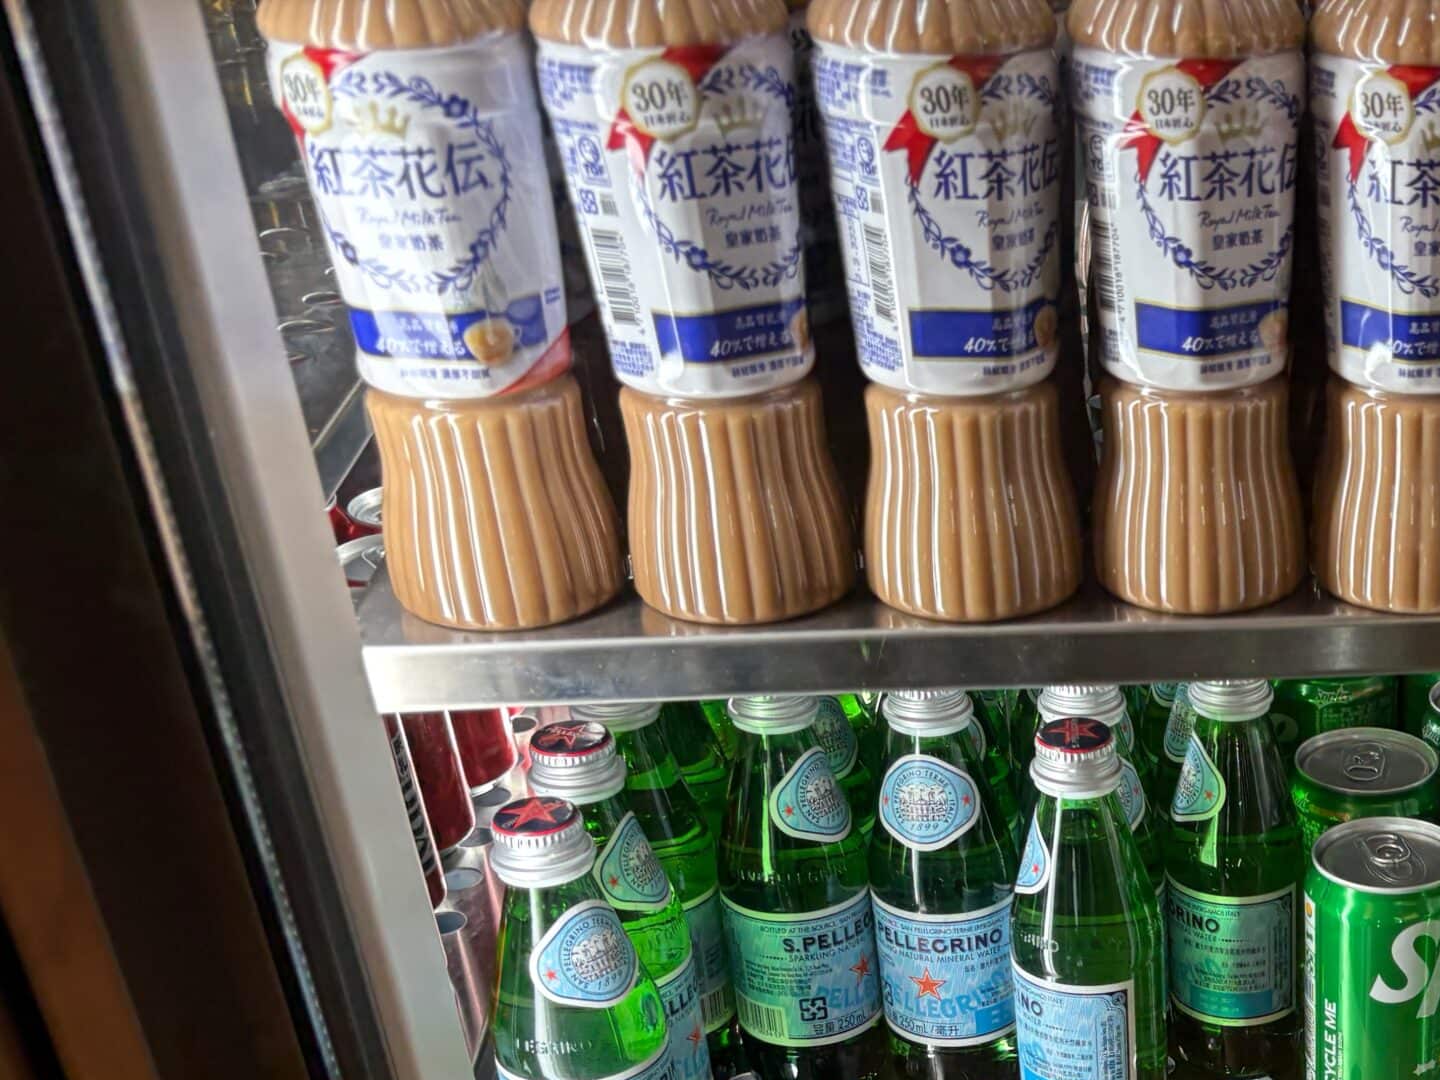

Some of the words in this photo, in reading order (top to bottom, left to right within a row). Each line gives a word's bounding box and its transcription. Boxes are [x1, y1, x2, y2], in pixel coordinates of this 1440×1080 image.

[920, 85, 969, 114] 30年
[1147, 86, 1195, 116] 30年
[1361, 92, 1404, 119] 30年
[308, 140, 494, 200] 紅茶花伝
[562, 921, 590, 973] PELLEGRINO
[1323, 998, 1337, 1030] ME
